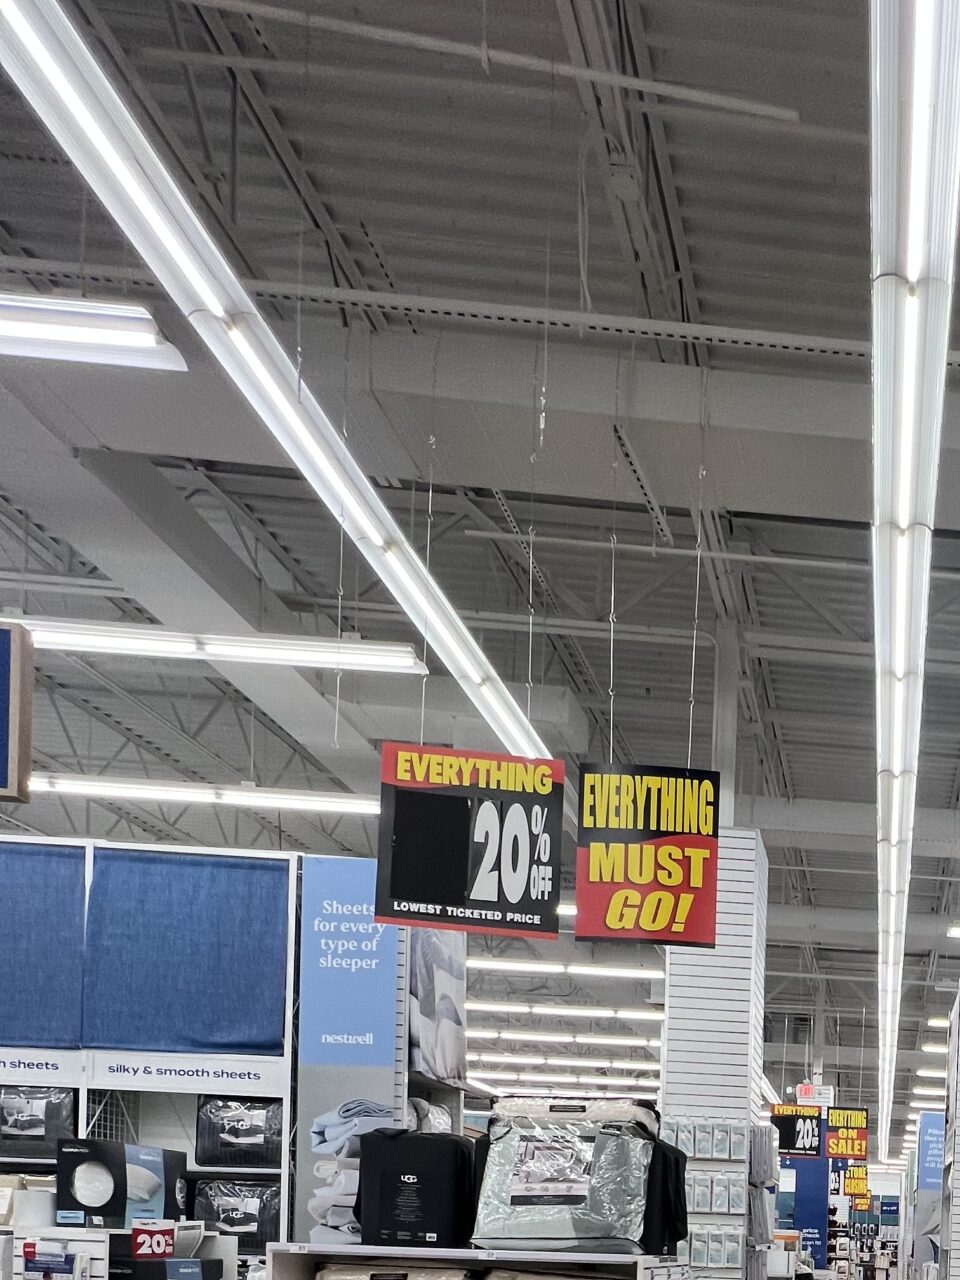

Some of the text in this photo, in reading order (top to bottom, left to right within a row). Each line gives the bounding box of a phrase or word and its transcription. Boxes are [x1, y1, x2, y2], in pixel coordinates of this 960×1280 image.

[397, 751, 553, 795] EVERYTHING
[583, 773, 714, 835] EVERYTHING
[589, 842, 710, 888] MUST
[530, 865, 552, 901] OFF
[322, 900, 376, 915] Sheets
[393, 901, 541, 925] LOWEST TICKETED PRICE
[605, 889, 694, 932] GO!
[313, 917, 386, 937] for every
[320, 937, 381, 953] type of
[319, 954, 379, 972] sleeper
[321, 1033, 374, 1045] nestwell
[9, 1059, 59, 1070] sheets
[108, 1064, 261, 1081] silky & smooth sheets
[774, 1105, 819, 1117] EVERYTHING
[829, 1109, 867, 1128] EVERYTHING
[838, 1128, 857, 1139] ON
[828, 1139, 867, 1155] SALE!
[401, 1174, 417, 1183] UGG
